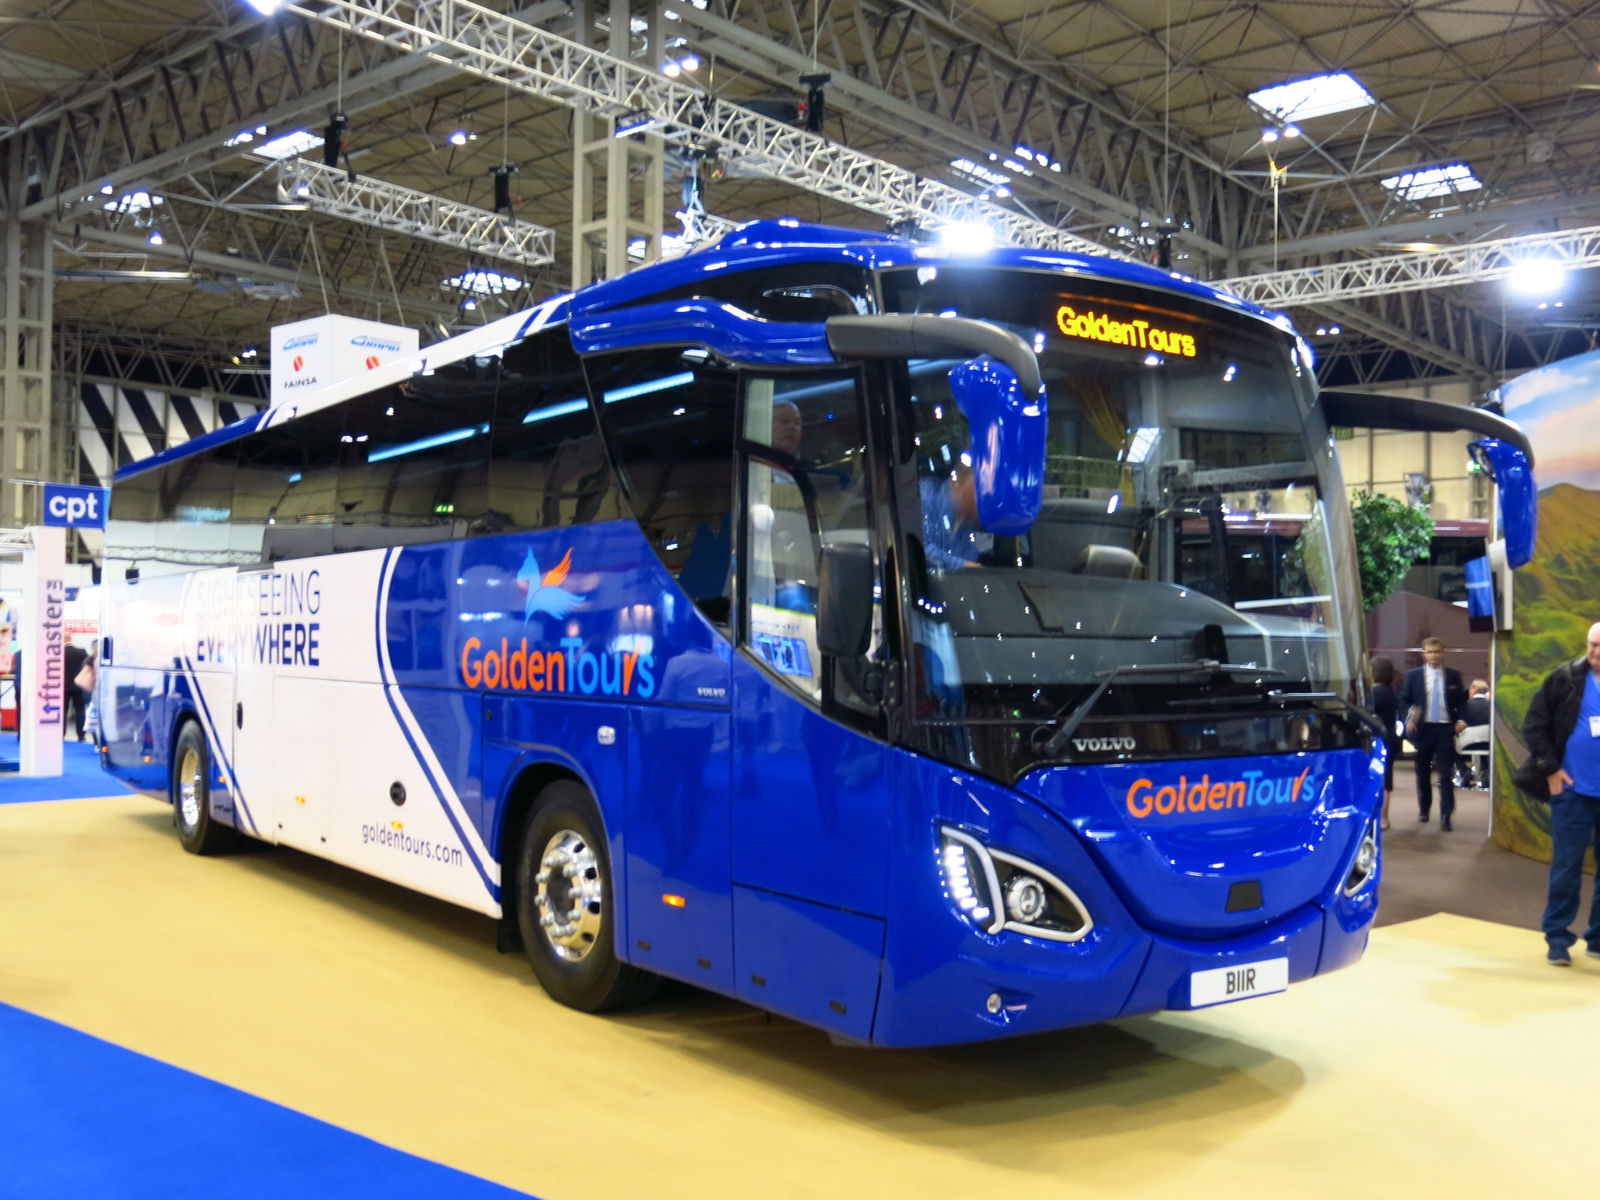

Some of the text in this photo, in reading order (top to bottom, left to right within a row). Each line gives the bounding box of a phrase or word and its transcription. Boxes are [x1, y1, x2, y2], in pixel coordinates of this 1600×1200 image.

[49, 492, 98, 523] cpt
[697, 687, 726, 697] VOLVO
[1072, 736, 1136, 751] VOLVO
[362, 822, 463, 868] goldentours.com
